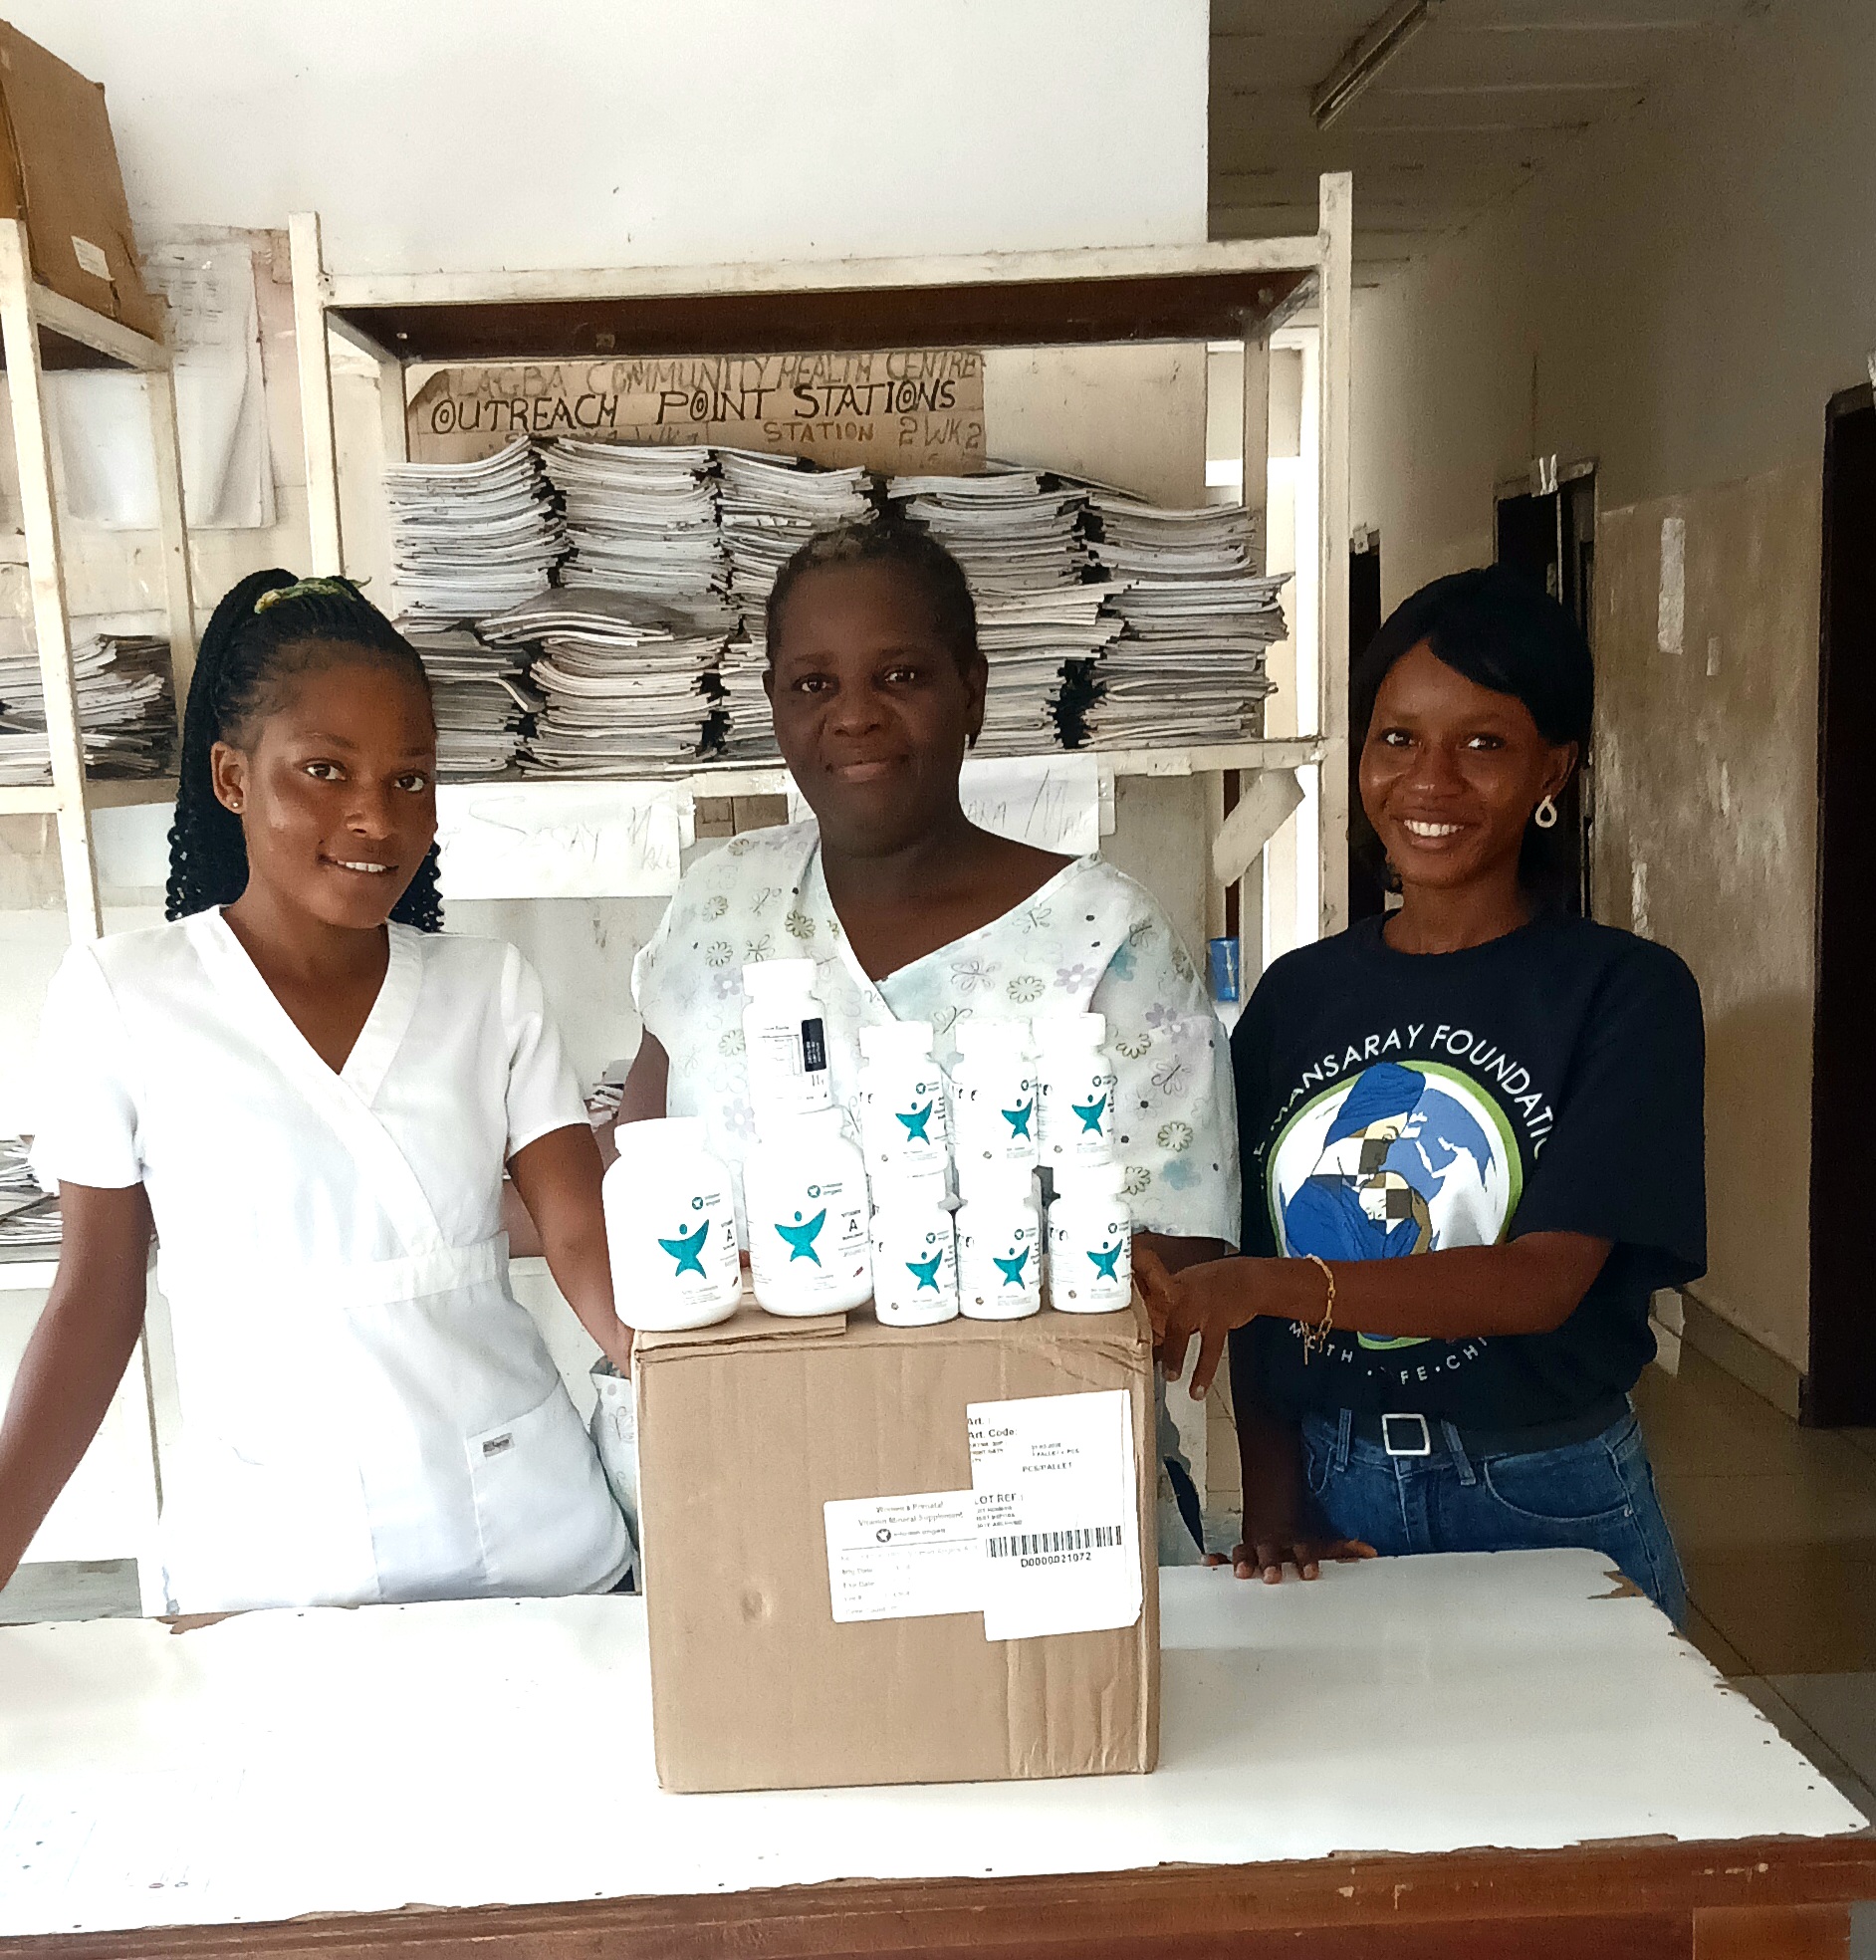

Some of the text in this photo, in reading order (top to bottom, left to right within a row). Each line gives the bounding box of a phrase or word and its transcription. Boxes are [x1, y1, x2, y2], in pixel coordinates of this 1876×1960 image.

[586, 355, 770, 396] COMMUNITY
[886, 351, 984, 381] CENTRE
[430, 378, 957, 434] OUTREACH POINT STATIONS
[763, 420, 874, 443] STATION
